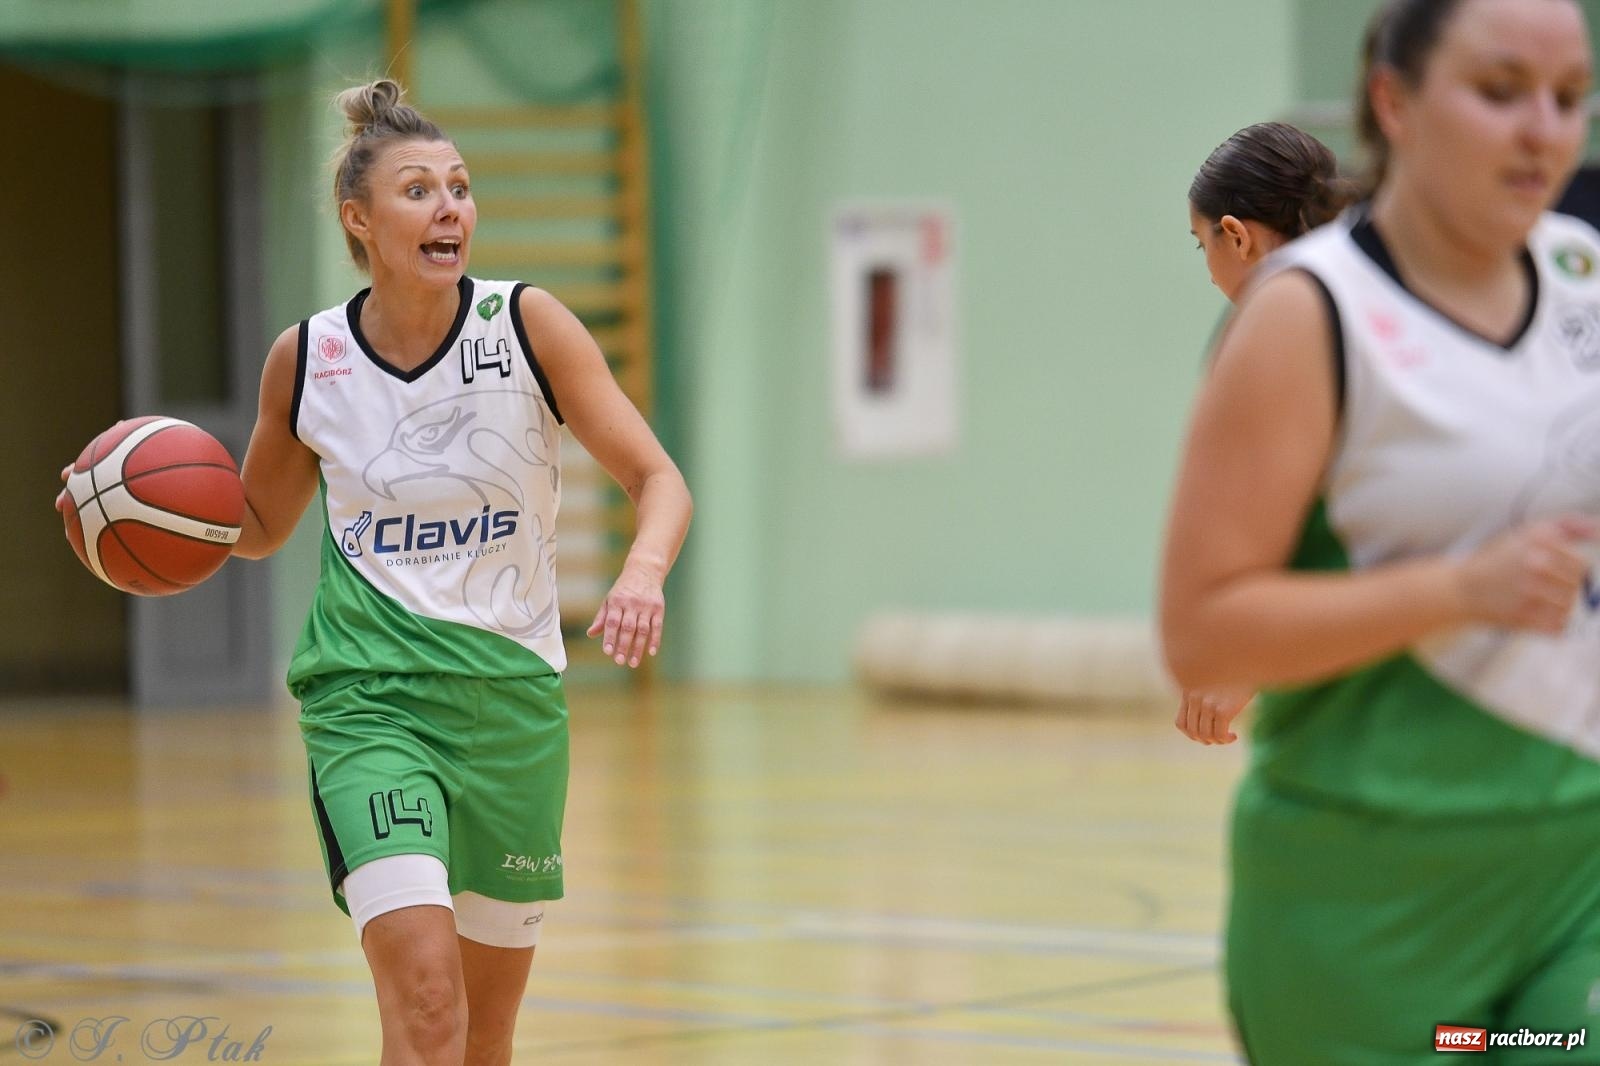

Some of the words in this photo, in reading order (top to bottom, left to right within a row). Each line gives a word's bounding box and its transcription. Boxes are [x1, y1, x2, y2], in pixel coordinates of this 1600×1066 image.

[314, 368, 352, 380] RACIBÓRZ
[461, 338, 511, 384] 14
[373, 504, 519, 554] Clavis
[386, 552, 461, 567] DORABIANIE
[467, 542, 508, 559] KLUCZY
[369, 789, 432, 840] 14
